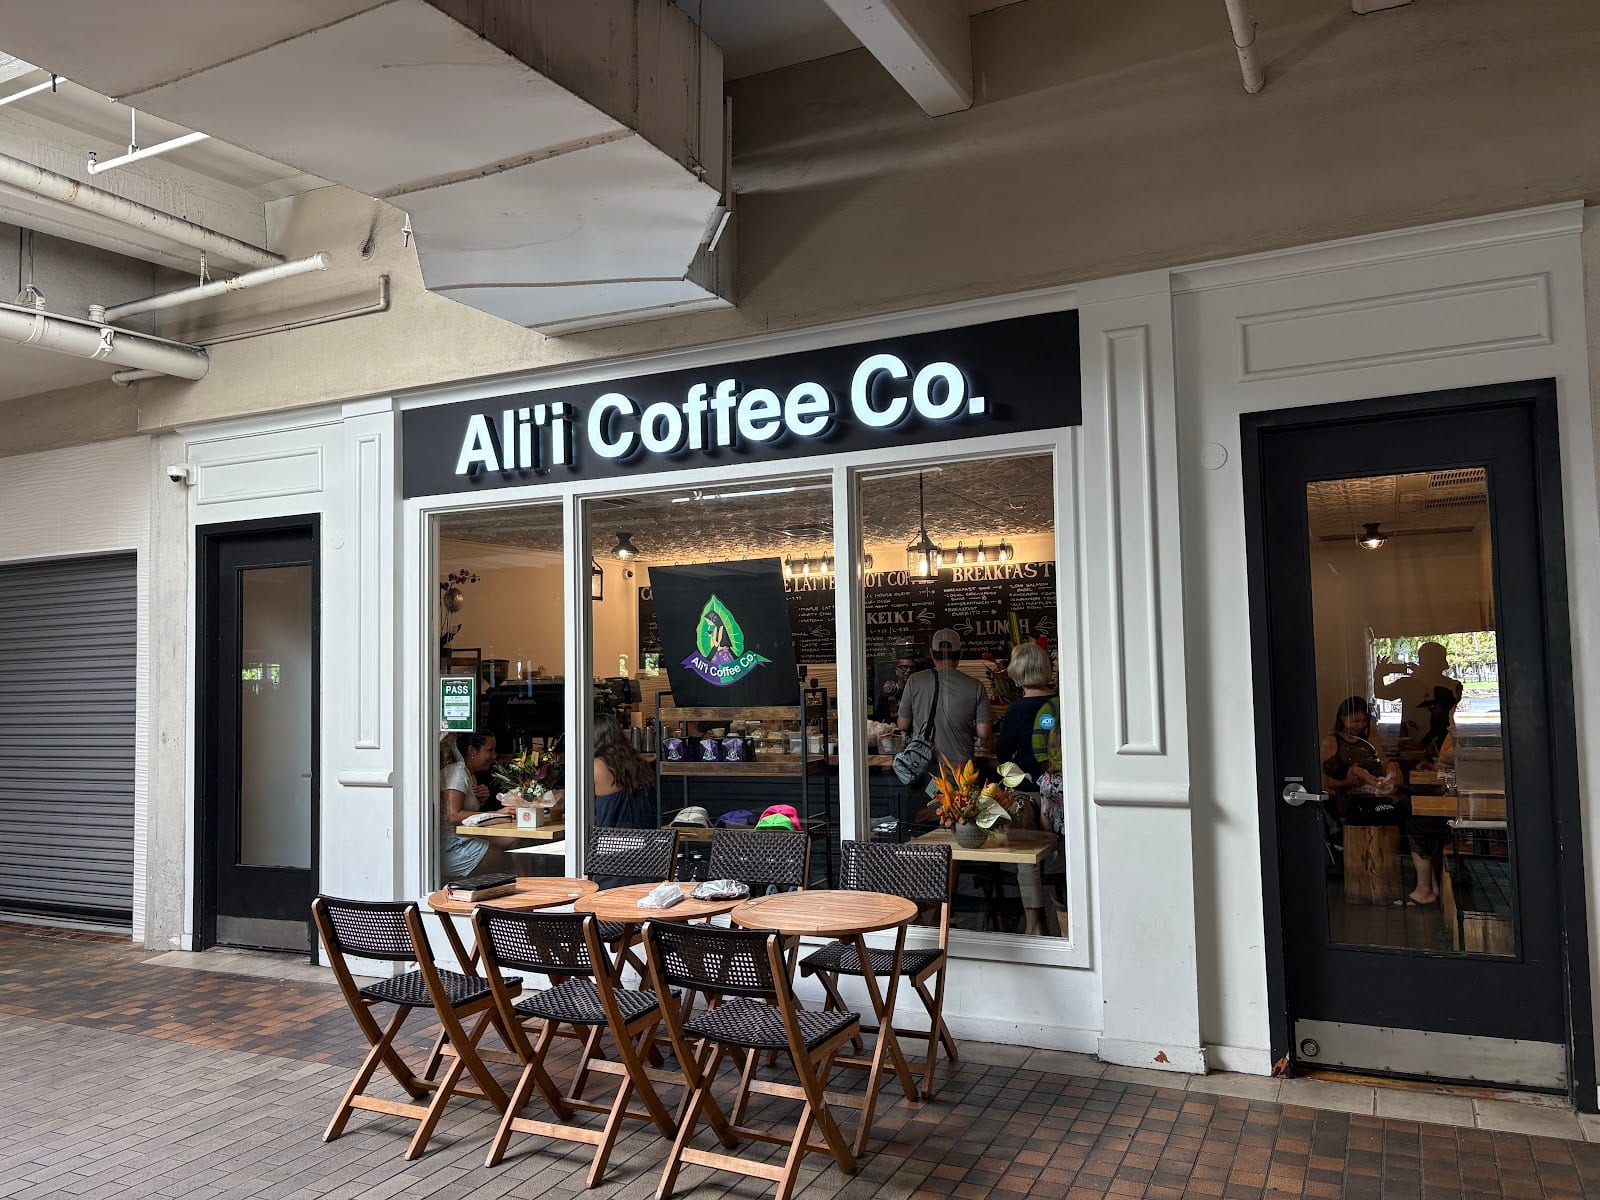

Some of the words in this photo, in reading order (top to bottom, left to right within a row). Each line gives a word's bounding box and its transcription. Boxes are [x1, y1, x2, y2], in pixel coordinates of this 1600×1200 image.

[455, 401, 565, 475] Ali'i
[587, 378, 830, 458] Coffee
[851, 353, 986, 427] Co.
[951, 561, 1054, 583] BREAKFAST
[866, 610, 915, 625] KEIKI
[975, 618, 1030, 636] LUNH
[691, 656, 709, 674] Ali'i
[709, 664, 741, 678] Coffee
[740, 652, 757, 668] Co.
[445, 685, 469, 695] PASS
